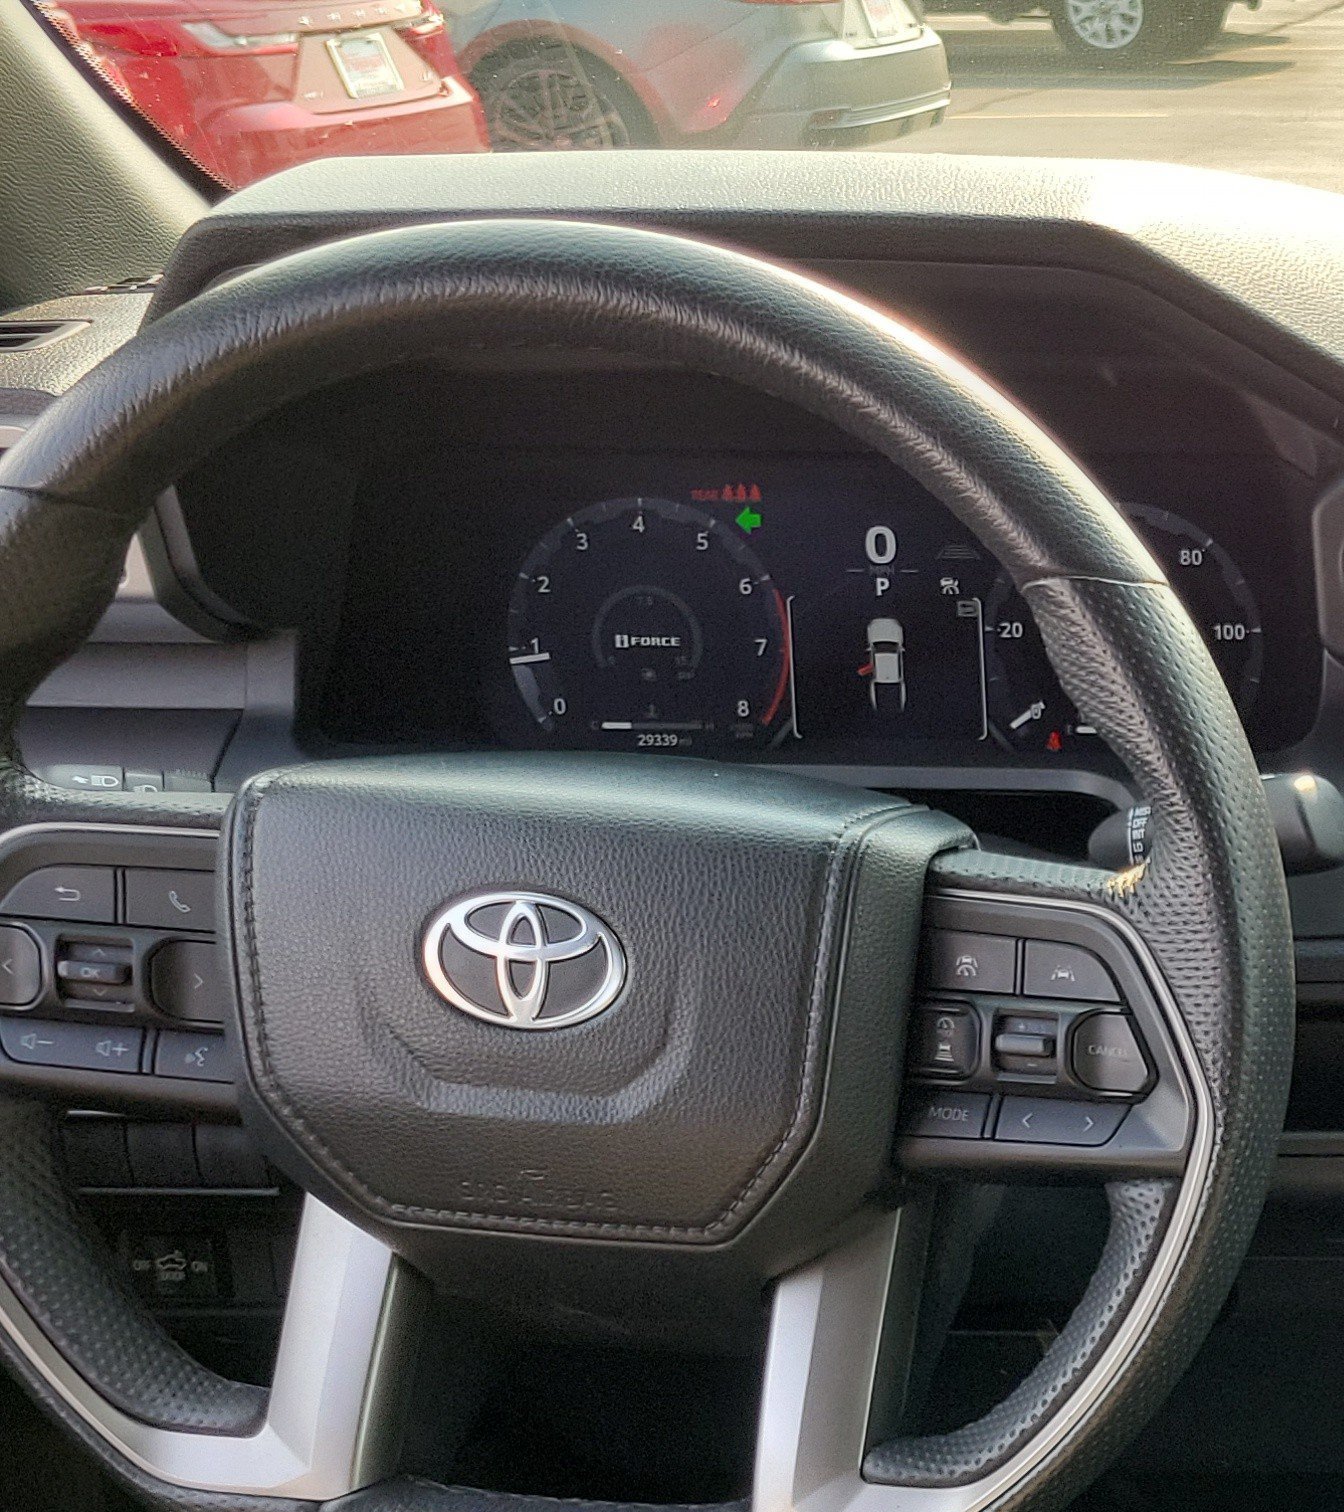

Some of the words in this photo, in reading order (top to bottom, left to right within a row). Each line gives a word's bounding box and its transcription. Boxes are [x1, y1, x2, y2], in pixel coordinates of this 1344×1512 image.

[633, 515, 645, 533] 4
[576, 533, 588, 550] 3
[697, 533, 708, 550] 5
[865, 525, 897, 564] 0
[1180, 549, 1202, 566] 80
[537, 576, 550, 593] 2
[739, 578, 752, 595] 6
[876, 577, 890, 596] P
[999, 622, 1023, 638] 20
[1213, 624, 1245, 640] 100
[531, 638, 540, 654] 1
[755, 638, 767, 656] 7
[553, 698, 566, 715] 0
[737, 700, 749, 717] 8
[637, 734, 678, 747] 29339
[79, 967, 99, 978] OK
[929, 1106, 969, 1121] MODE
